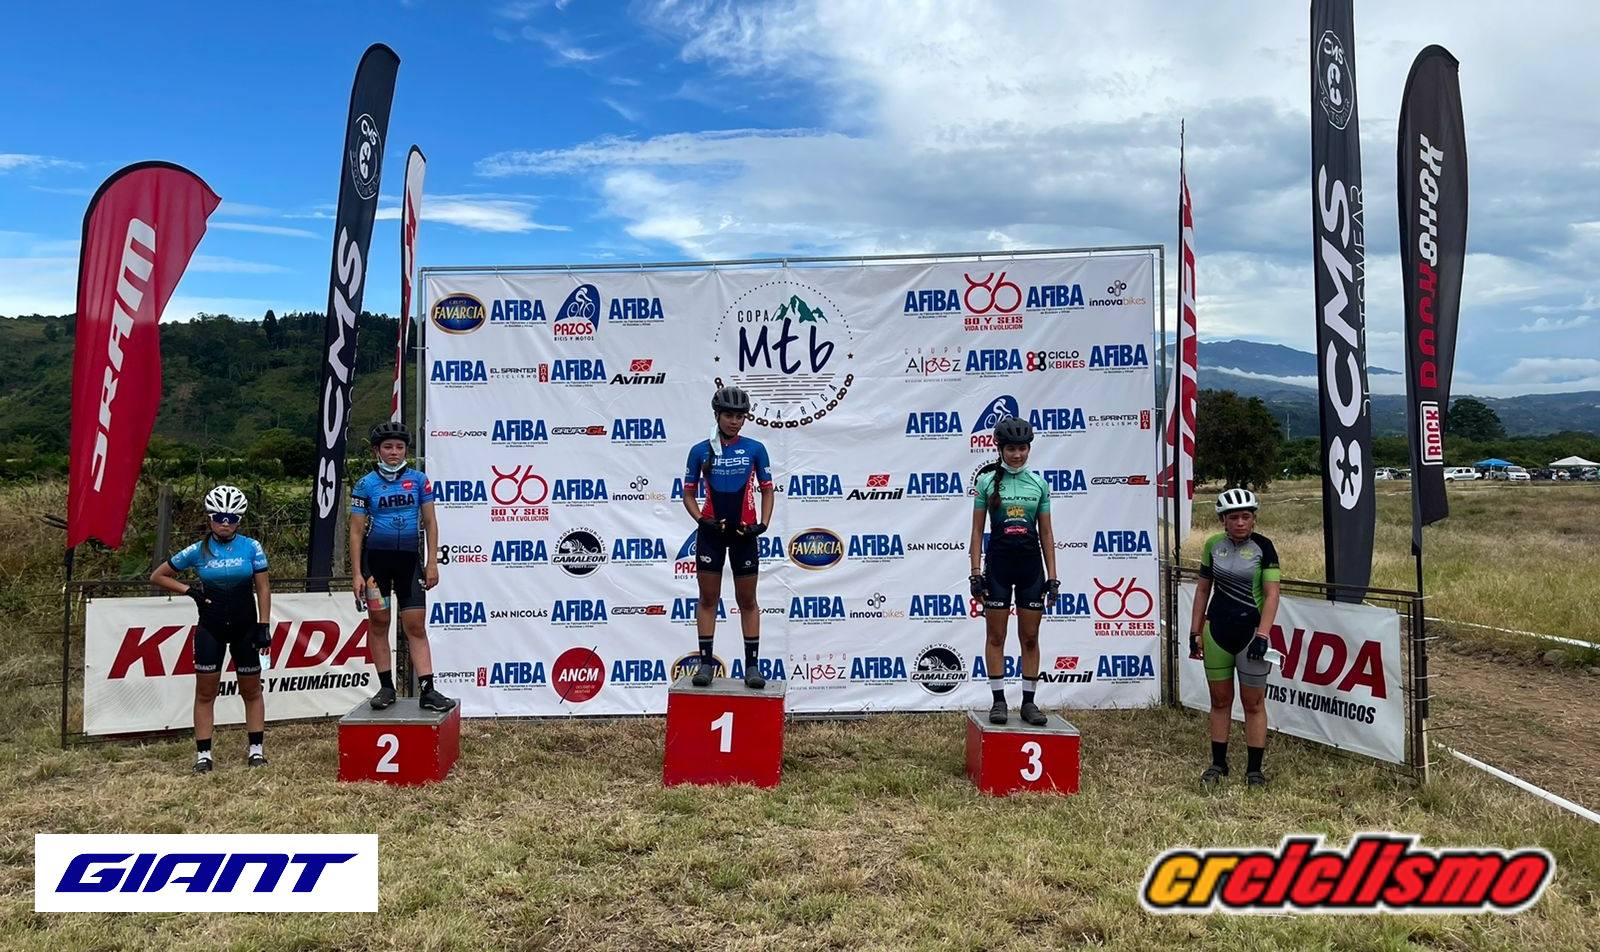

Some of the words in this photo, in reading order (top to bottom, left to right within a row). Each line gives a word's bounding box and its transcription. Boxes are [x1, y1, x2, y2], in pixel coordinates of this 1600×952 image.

[1089, 296, 1146, 306] innovabikes
[1318, 163, 1361, 428] CMS
[434, 306, 484, 319] FAVARCIA
[737, 310, 770, 323] COPA
[964, 316, 980, 325] 80
[984, 316, 992, 325] Y
[997, 316, 1023, 325] SEIS
[554, 322, 593, 336] PAZOS
[323, 226, 363, 450] CMS
[1048, 350, 1079, 359] CICLO
[1049, 359, 1085, 369] KBIKES
[609, 372, 667, 385] Avimil
[800, 384, 837, 416] RICA
[1427, 408, 1442, 458] ROCK
[971, 435, 998, 447] PAZ
[612, 492, 666, 501] innovabikes
[845, 488, 904, 501] Avimil
[451, 545, 482, 554] CICLO
[791, 541, 841, 555] FAVARCIA
[907, 543, 925, 551] SAN
[451, 554, 488, 563] KBIKES
[553, 555, 606, 563] CAMALEON
[675, 562, 697, 574] PAZ
[490, 610, 508, 618] SAN
[671, 598, 727, 619] AFA
[850, 608, 904, 618] innovabikes
[558, 667, 599, 682] ANCM
[912, 673, 966, 681] CAMALEON
[1037, 671, 1094, 683] Avimil
[268, 677, 279, 692] Y
[279, 671, 370, 692] NEUMÁTICOS
[1289, 687, 1298, 705] Y
[1298, 690, 1376, 724] NEUMÁTICOS
[710, 711, 734, 753] 1
[375, 733, 400, 773] 2
[1020, 741, 1043, 782] 3
